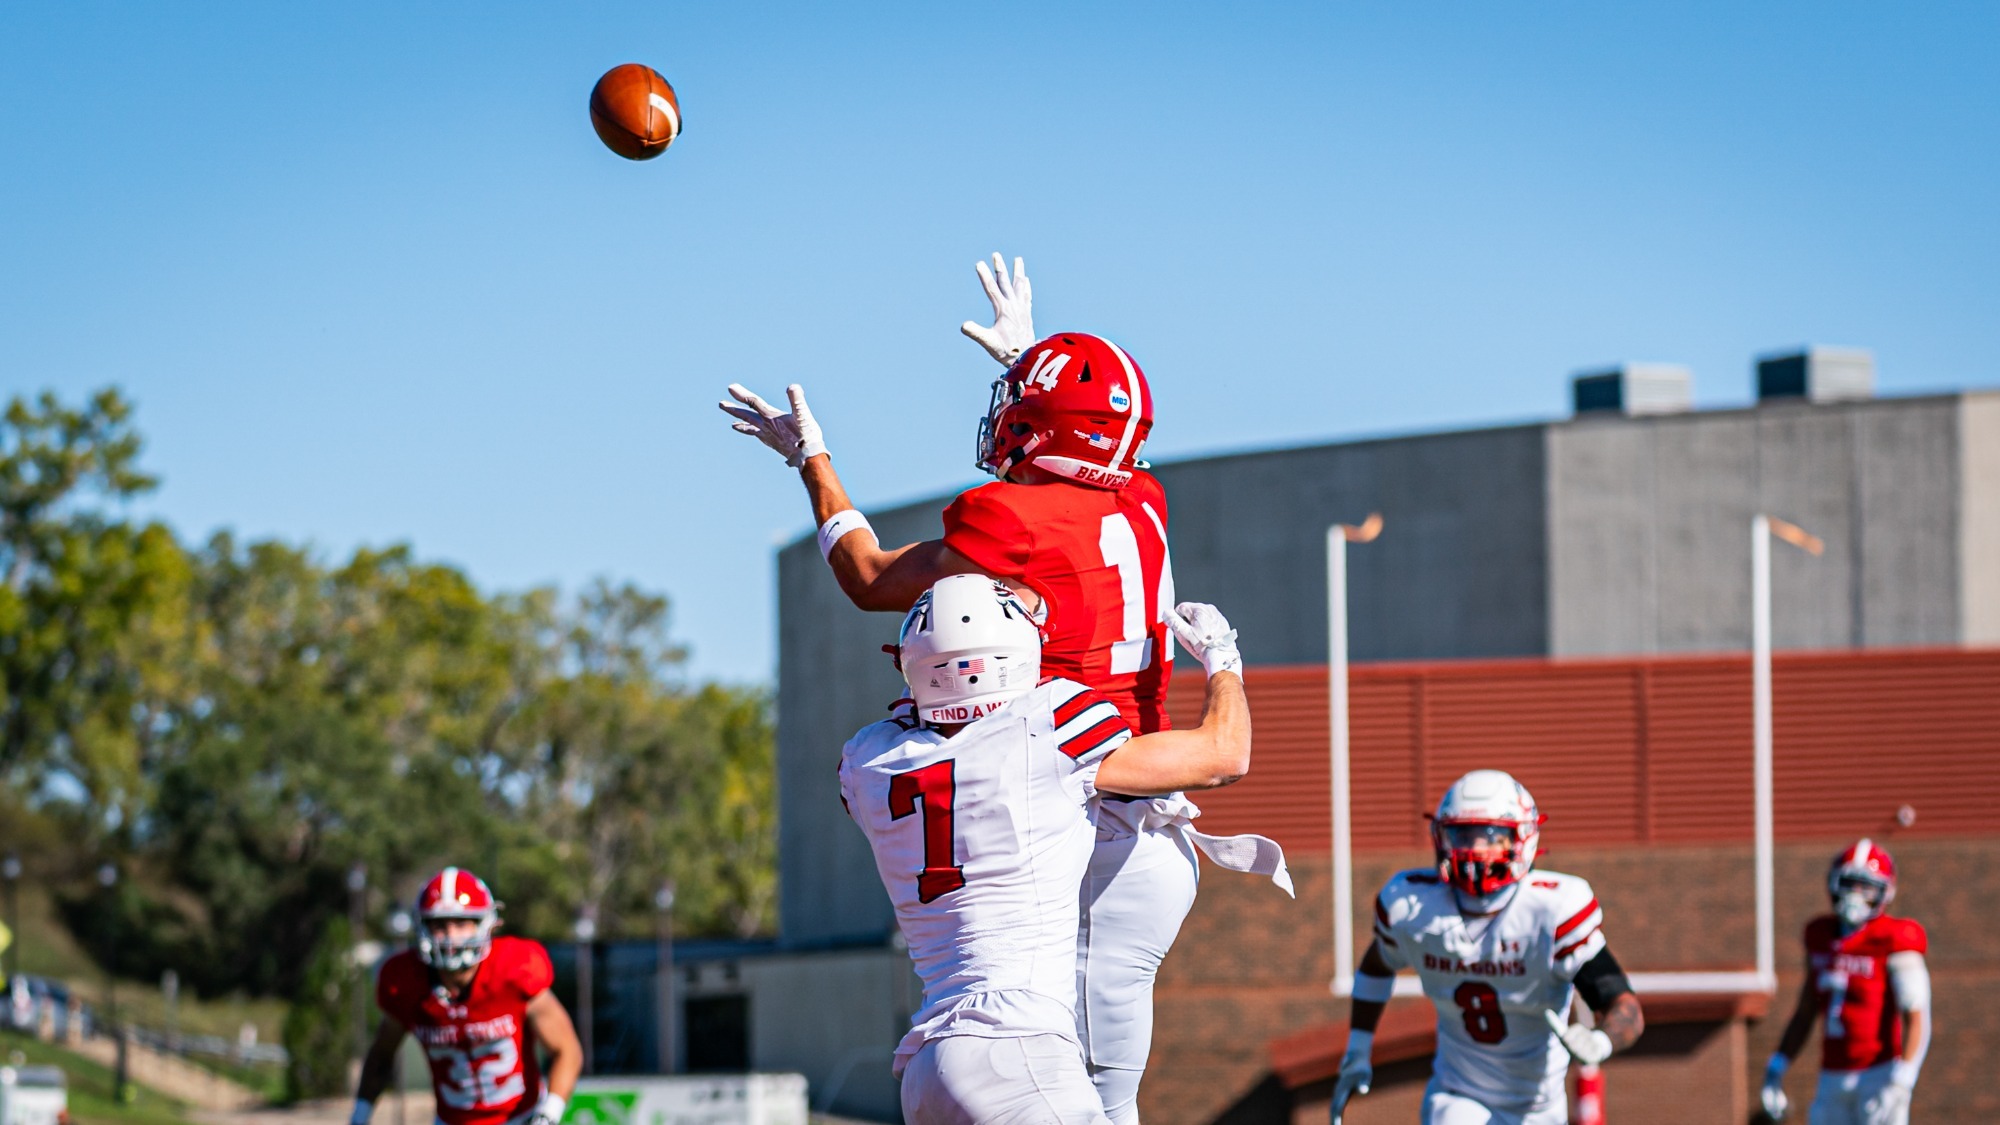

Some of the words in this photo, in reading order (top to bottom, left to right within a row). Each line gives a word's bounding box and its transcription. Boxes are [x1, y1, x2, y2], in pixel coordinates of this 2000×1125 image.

[1025, 349, 1071, 392] 14
[1075, 466, 1130, 488] BEAVER
[932, 708, 968, 721] FIND
[972, 705, 984, 719] A
[888, 758, 966, 904] 7
[1424, 953, 1526, 976] DRAGONS
[1454, 981, 1508, 1045] 8
[428, 1037, 526, 1110] 32
